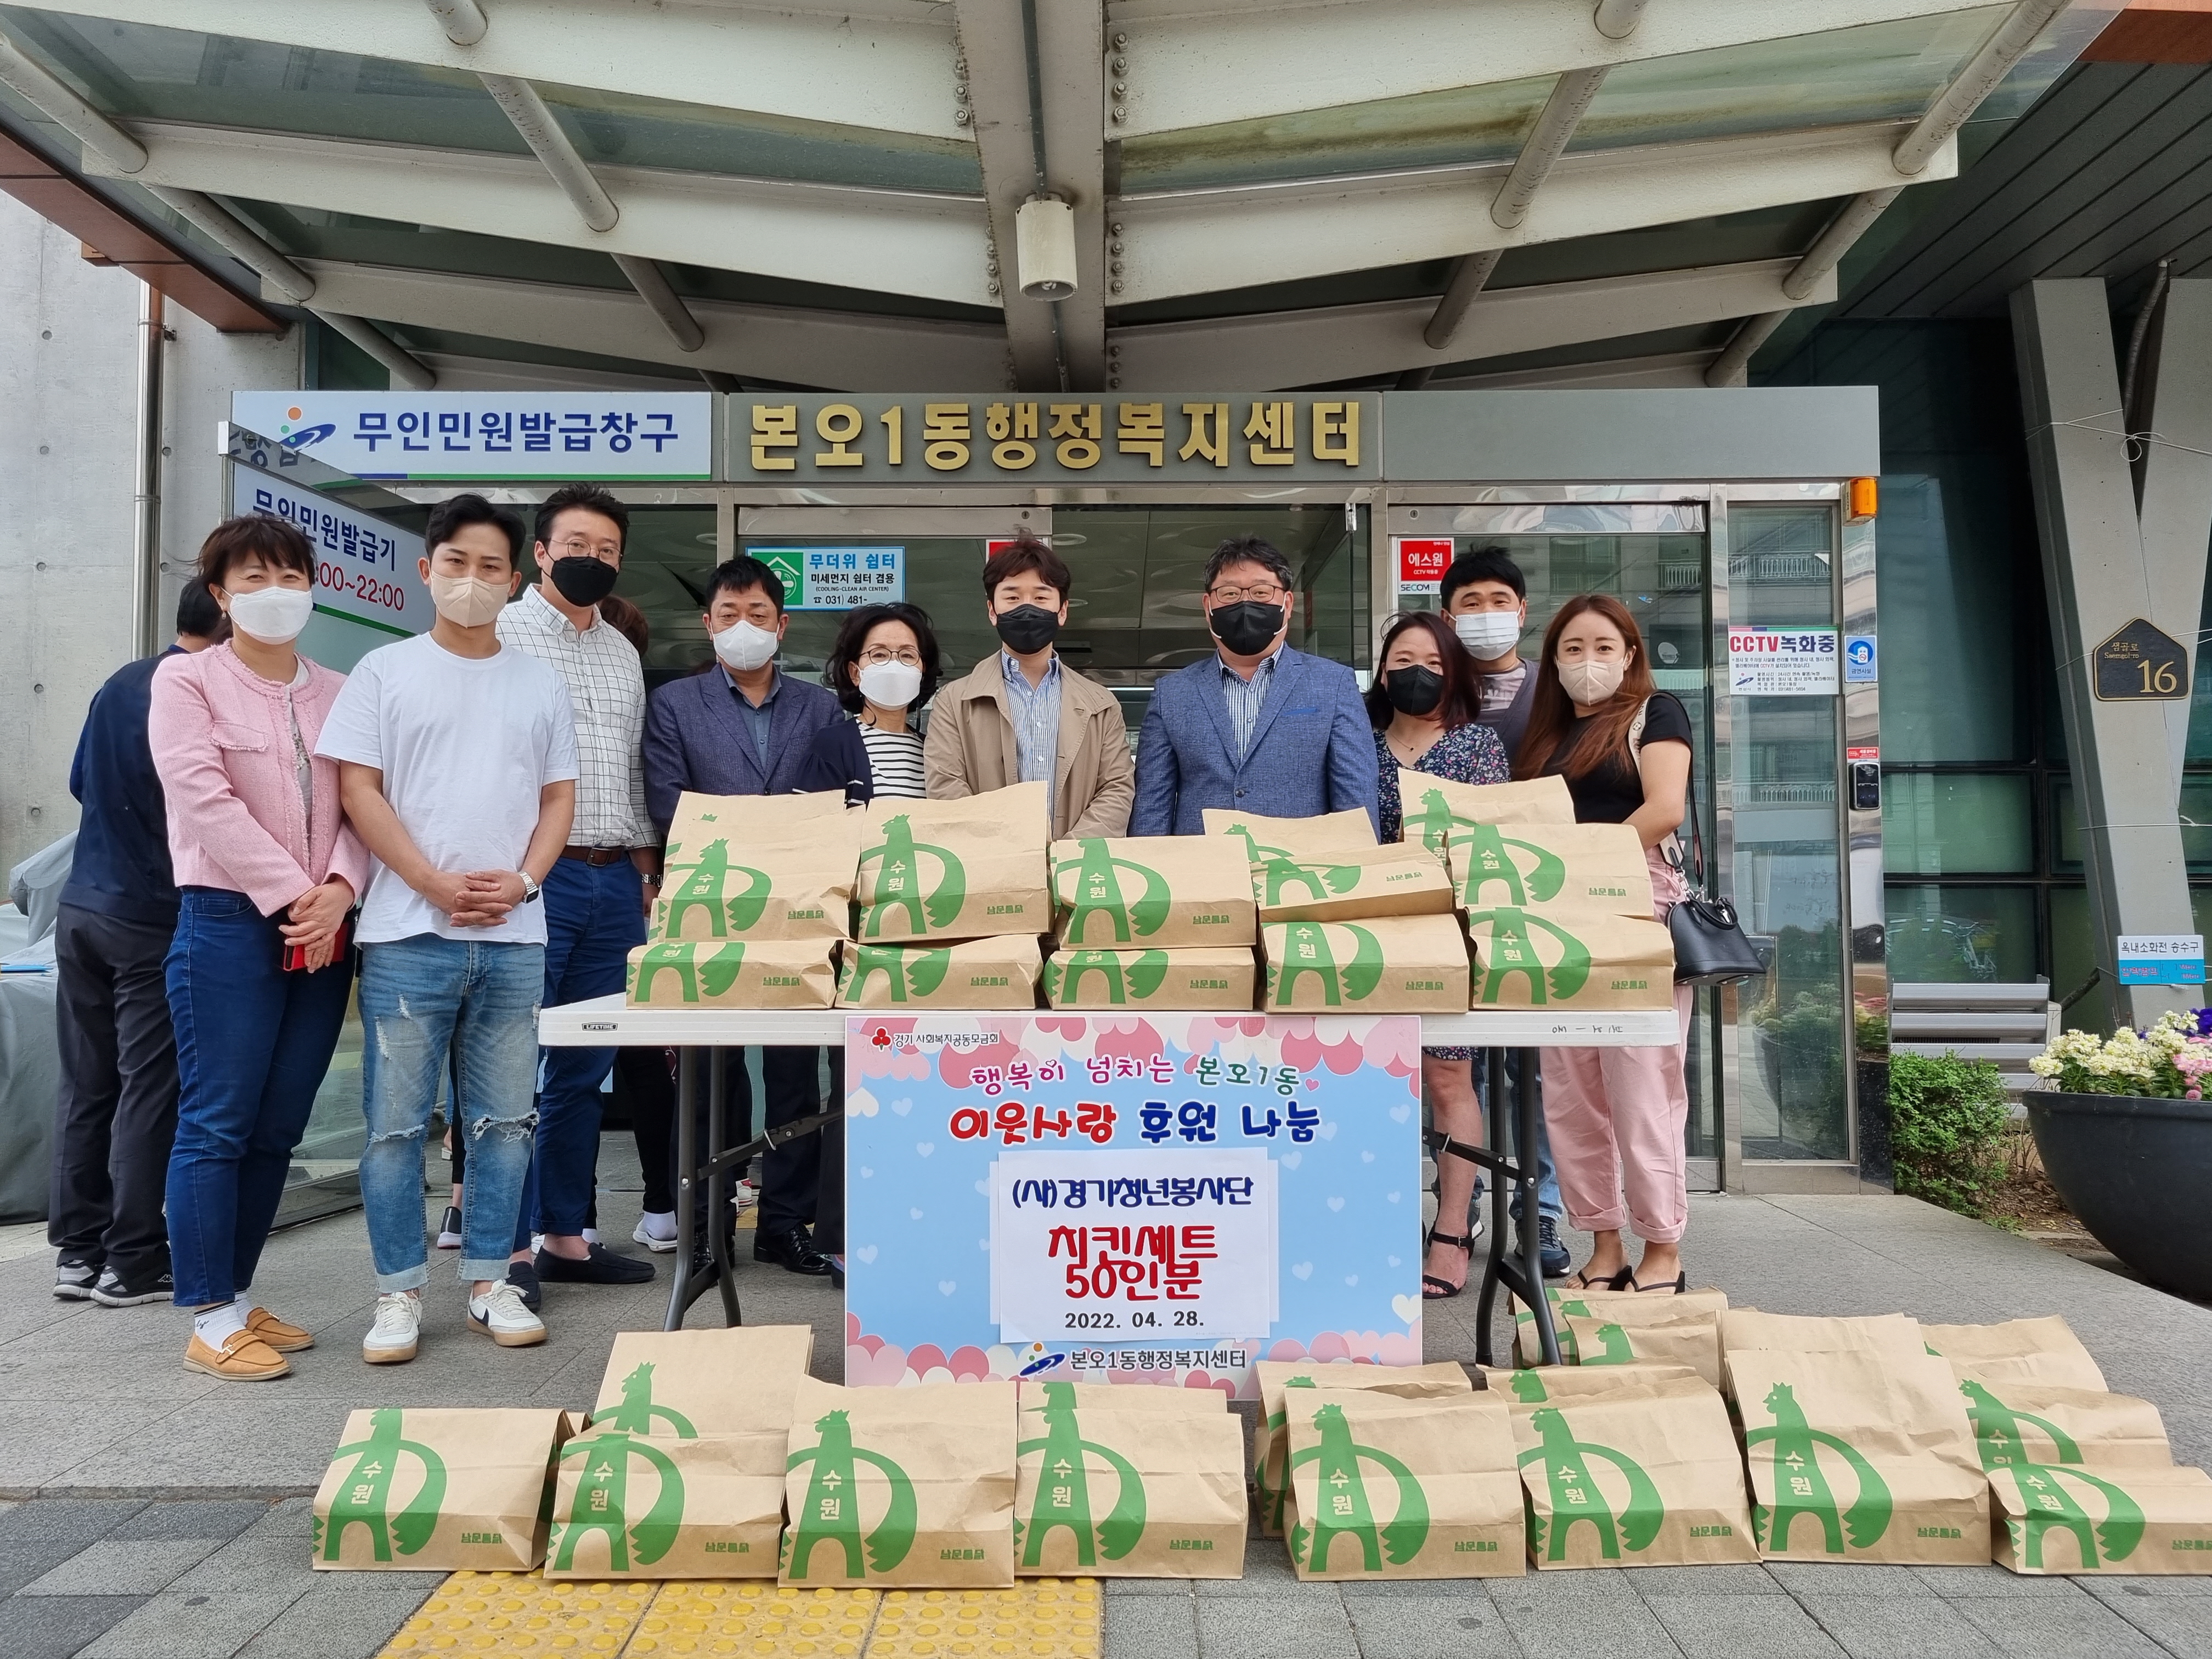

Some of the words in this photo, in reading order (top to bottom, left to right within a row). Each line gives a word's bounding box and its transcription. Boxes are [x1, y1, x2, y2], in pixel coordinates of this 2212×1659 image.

[354, 411, 679, 453] 무인민원발급창구
[751, 401, 1359, 471] 본오1동행정복지센터
[809, 554, 856, 569] 무더위
[865, 554, 895, 569] 쉼터
[1408, 552, 1443, 567] 에스원
[315, 562, 404, 611] :00~22:00
[811, 573, 849, 584] 미세먼지
[853, 573, 871, 584] 쉼터
[876, 573, 895, 584] 겸용
[825, 594, 844, 605] 031)
[847, 595, 867, 604] 481-
[1729, 635, 1835, 653] CCTV녹화중
[2111, 642, 2140, 652] 샘골로
[2137, 659, 2177, 693] 16
[1480, 848, 1501, 871] 수원
[692, 873, 714, 895] 수원
[888, 860, 906, 892] 수원
[1088, 872, 1107, 899] 수원
[1297, 927, 1317, 959] 수원
[1500, 929, 1523, 961] 수원
[2121, 941, 2167, 953] 옥내소화전
[2171, 941, 2199, 953] 송수구
[894, 1034, 913, 1047] 경기
[916, 1034, 998, 1047] 사회복지공동모금회
[971, 1059, 1064, 1096] 행복이
[1086, 1055, 1175, 1085] 넘치는
[1195, 1056, 1300, 1096] 본오1동
[950, 1102, 1117, 1145] 이웃사랑
[1139, 1100, 1216, 1144] 후원
[1242, 1101, 1320, 1143] 나눔
[1012, 1177, 1254, 1209] (사)경기청년봉사단
[1048, 1225, 1218, 1265] 치킨세트
[1065, 1261, 1203, 1301] 50인분
[1065, 1312, 1121, 1329] 2022.
[1132, 1311, 1163, 1328] 04.
[1173, 1311, 1204, 1327] 28.
[1070, 1350, 1246, 1369] 본오1동행정복지센터
[351, 1460, 382, 1505] 수원
[590, 1461, 614, 1513] 수원
[1052, 1458, 1073, 1508] 수원
[1558, 1465, 1588, 1504] 수원
[1785, 1450, 1813, 1496] 수원
[820, 1469, 842, 1521] 수원
[1330, 1467, 1355, 1515] 수원
[2027, 1475, 2064, 1510] 수원
